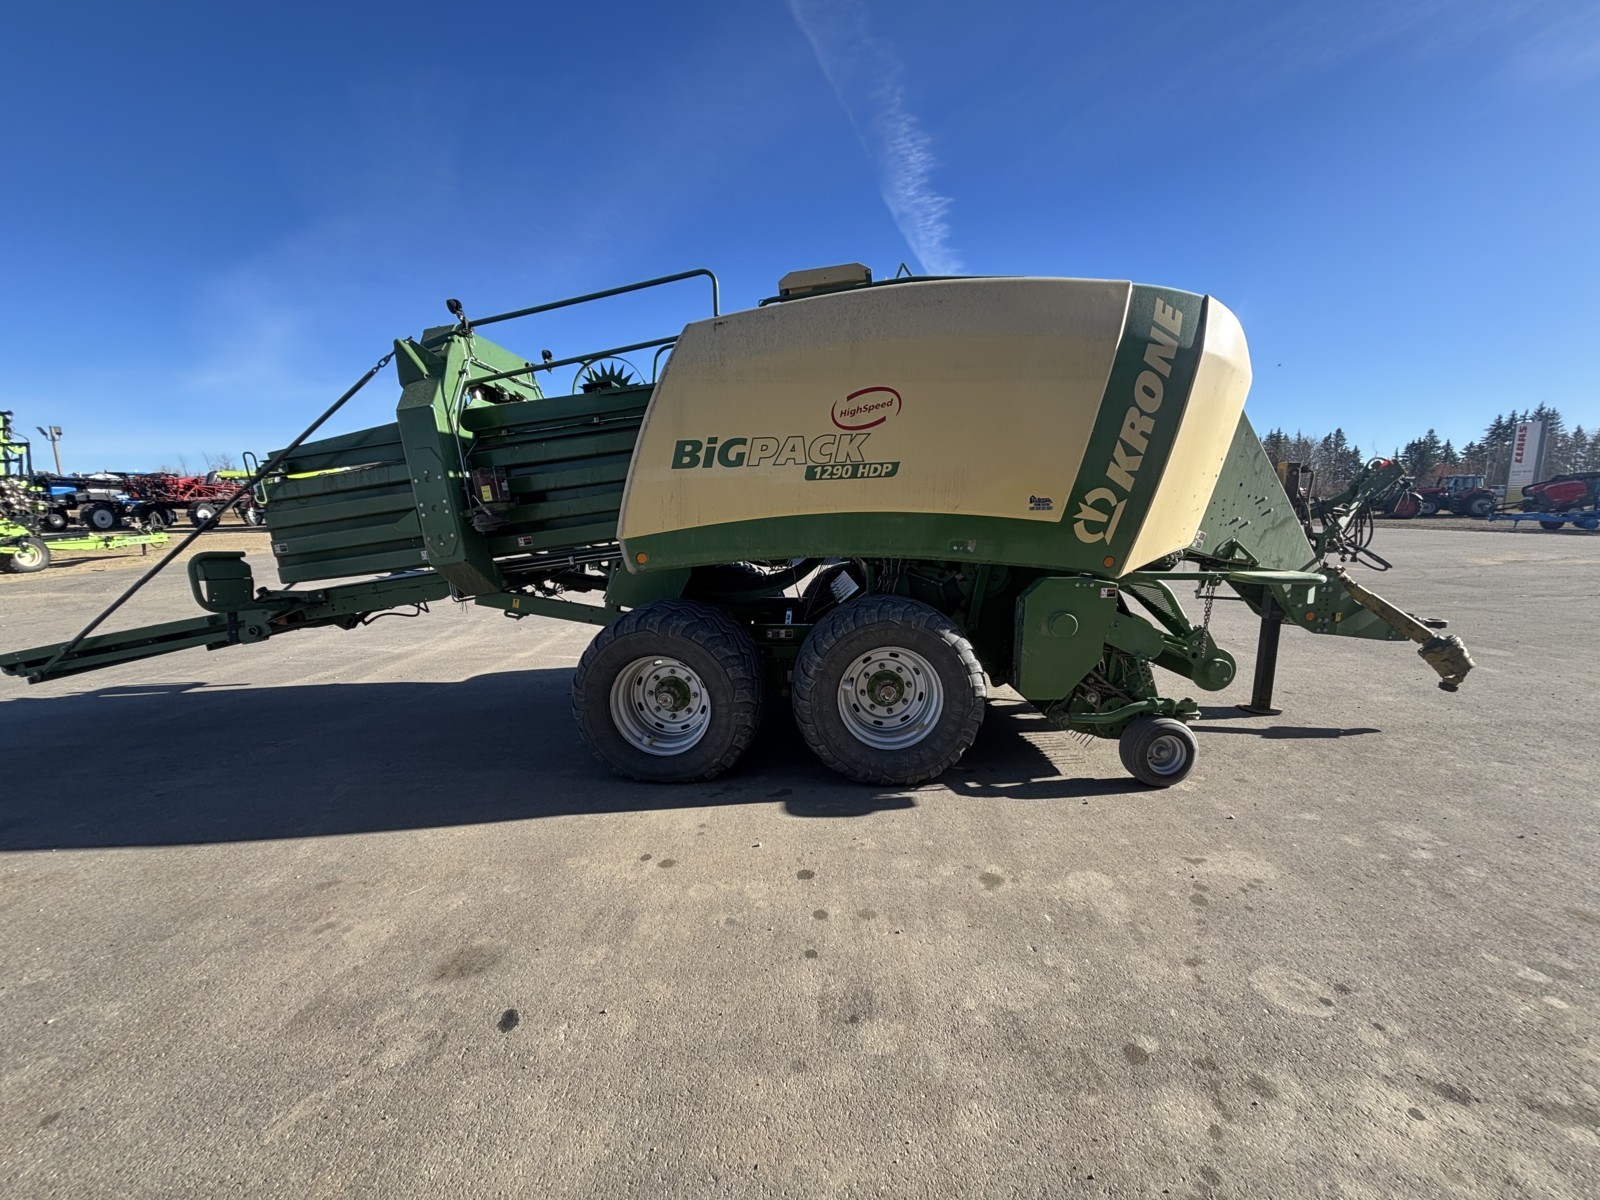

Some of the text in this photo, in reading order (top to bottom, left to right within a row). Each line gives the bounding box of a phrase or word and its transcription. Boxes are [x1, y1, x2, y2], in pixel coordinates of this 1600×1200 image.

[839, 398, 894, 418] HighSpeed
[1105, 297, 1184, 493] KRONE
[1514, 425, 1528, 464] CLAAS
[813, 463, 893, 479] 1290 HDP
